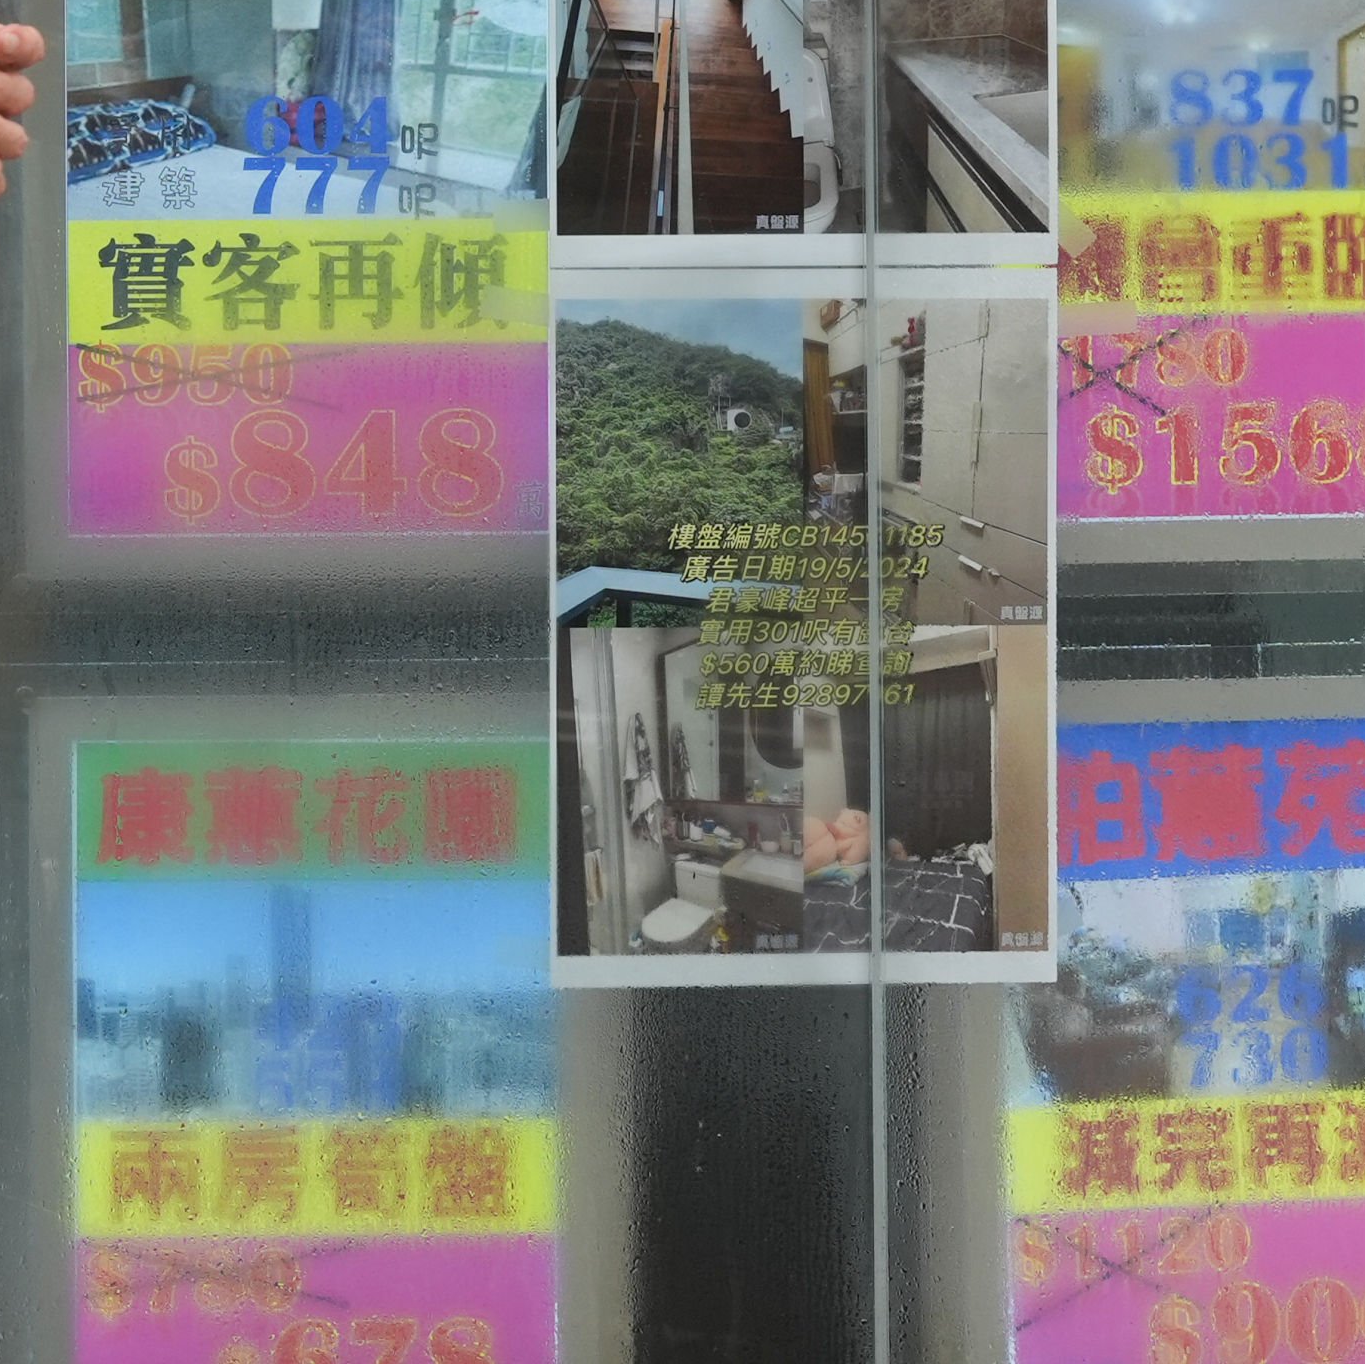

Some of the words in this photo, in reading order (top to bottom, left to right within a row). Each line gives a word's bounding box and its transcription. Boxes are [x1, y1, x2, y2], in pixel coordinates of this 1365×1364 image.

[245, 94, 401, 157] 604
[1169, 68, 1315, 127] 837
[242, 156, 391, 215] 777
[163, 407, 506, 524] $848
[667, 523, 945, 551] 樓盤編號CB1451185
[694, 682, 916, 710] 譚先生9289761
